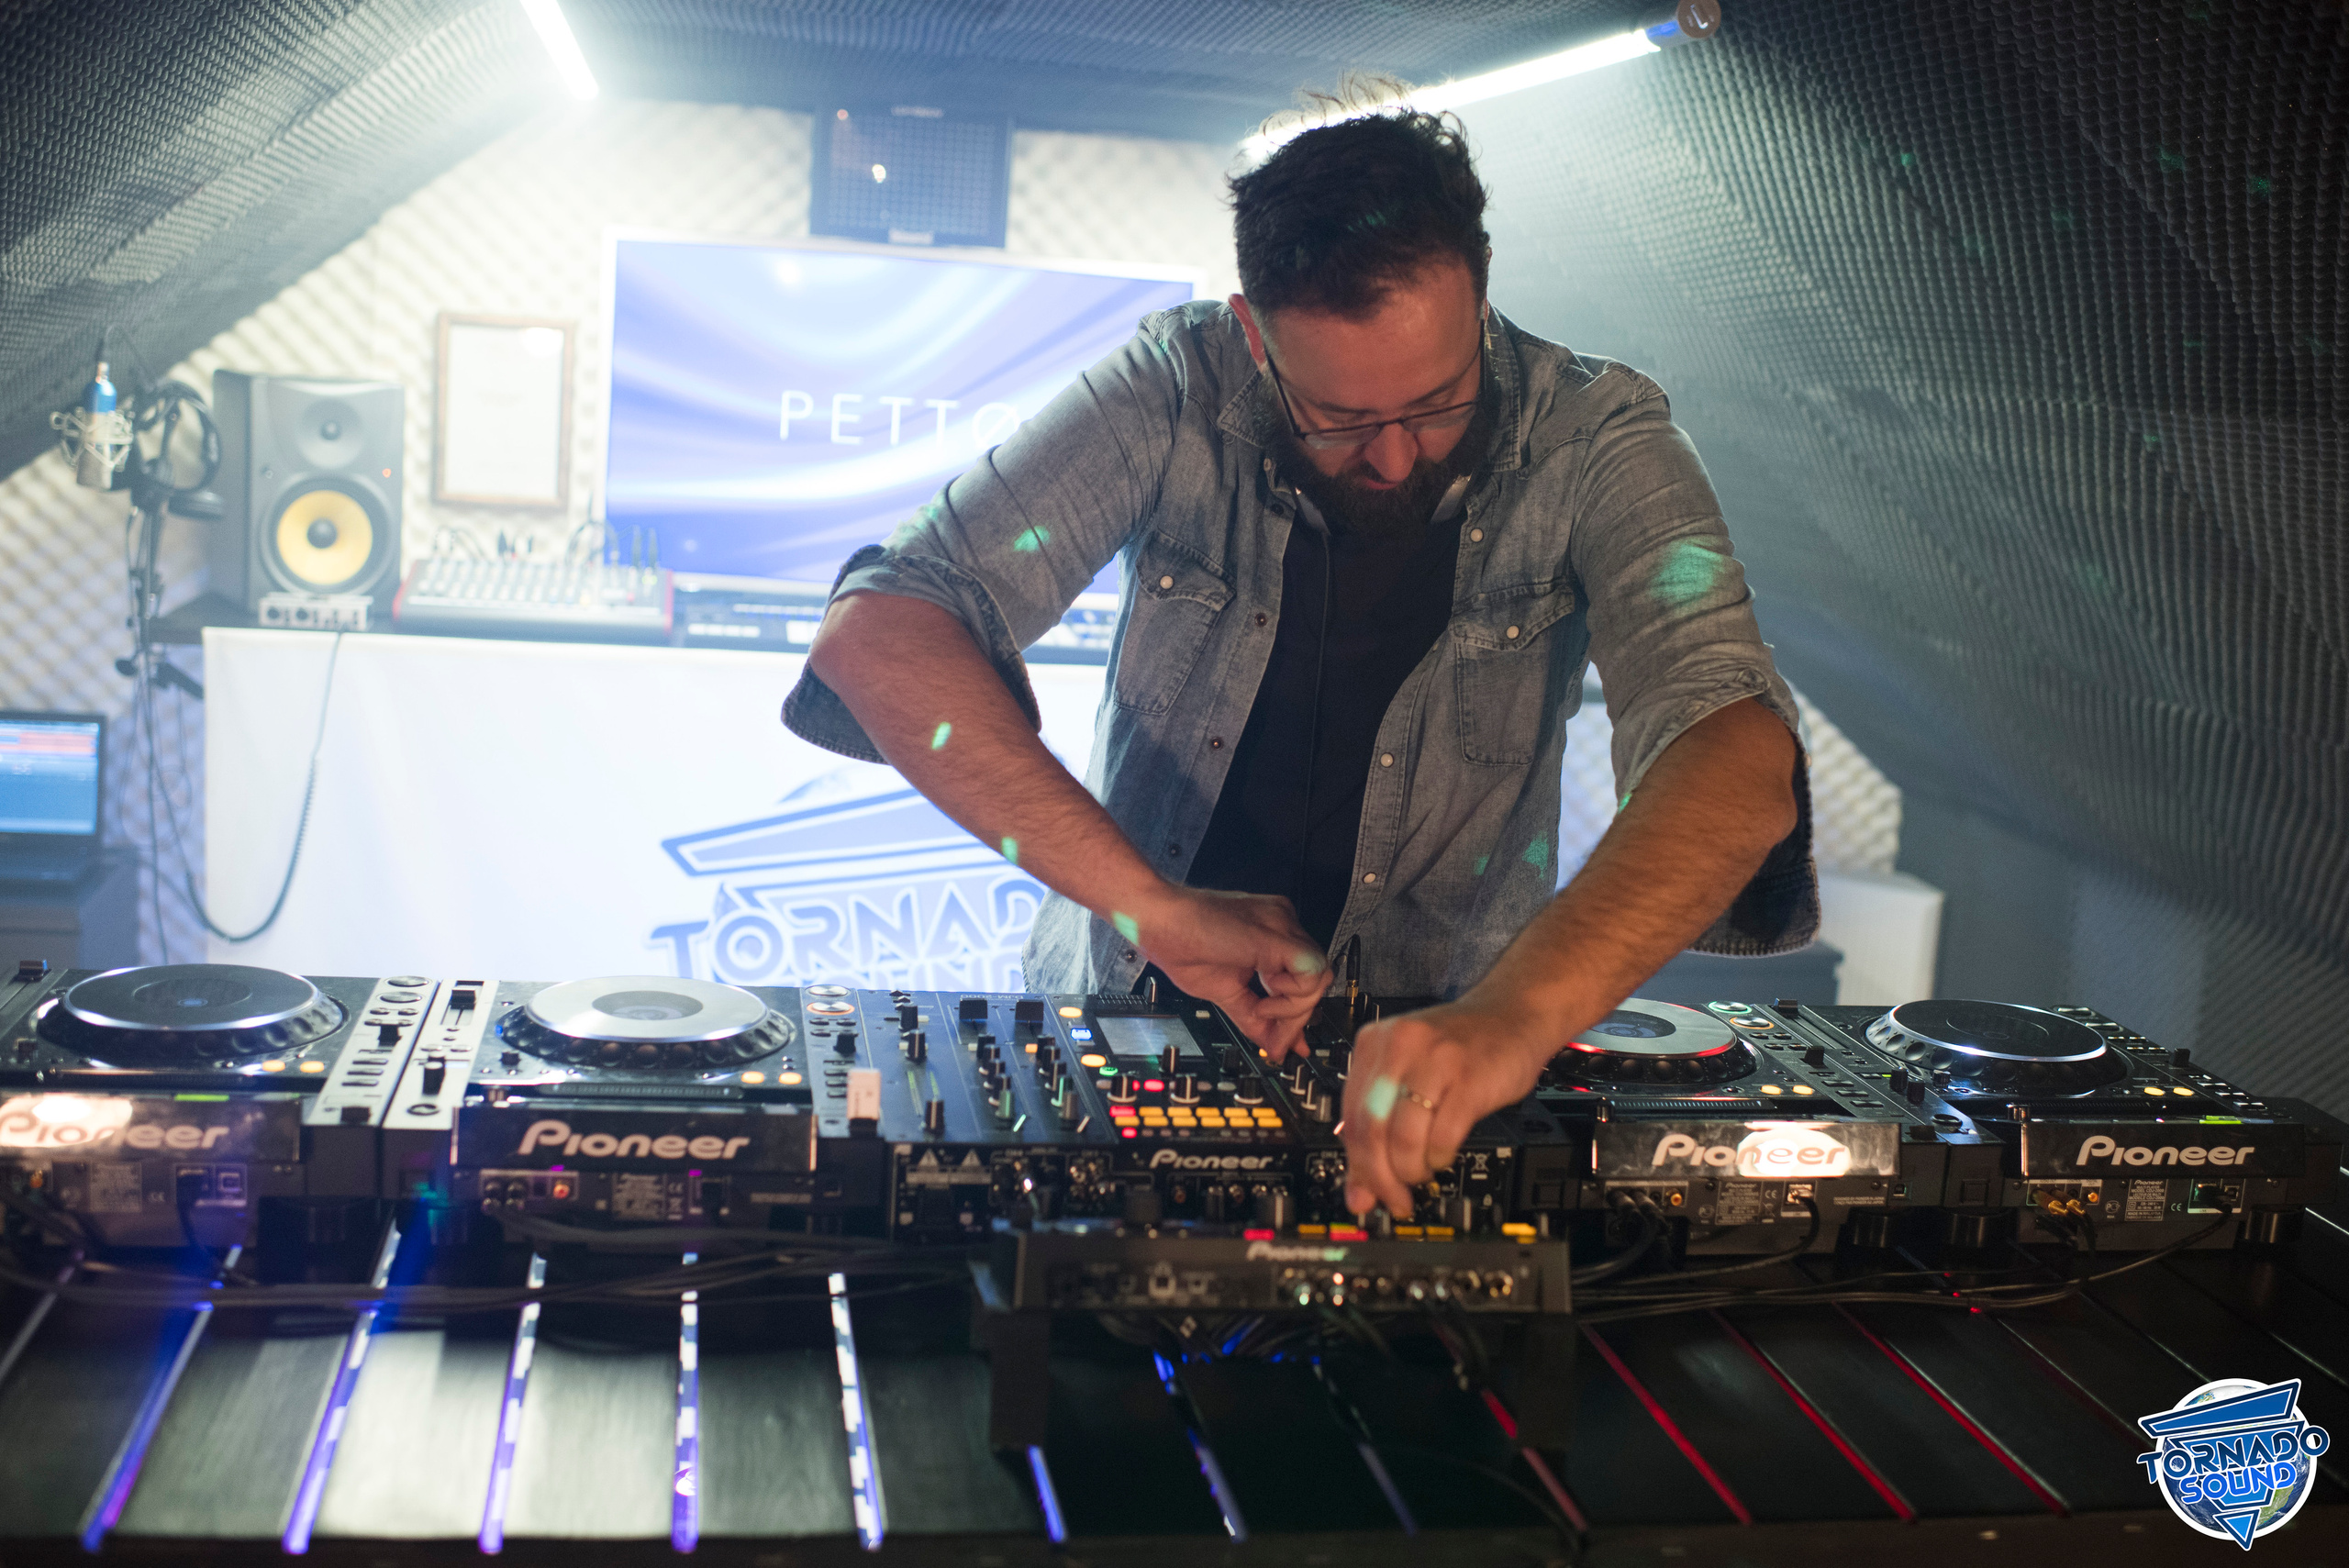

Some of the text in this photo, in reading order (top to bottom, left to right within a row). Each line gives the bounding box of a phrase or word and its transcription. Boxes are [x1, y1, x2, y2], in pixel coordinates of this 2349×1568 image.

[649, 876, 1047, 984] TORNAD
[0, 1111, 229, 1149] Pioneer
[518, 1119, 750, 1160] Pioneer
[1149, 1149, 1273, 1169] Pioneer
[1652, 1134, 1846, 1167] Pioneer
[2076, 1135, 2255, 1166] Pioneer
